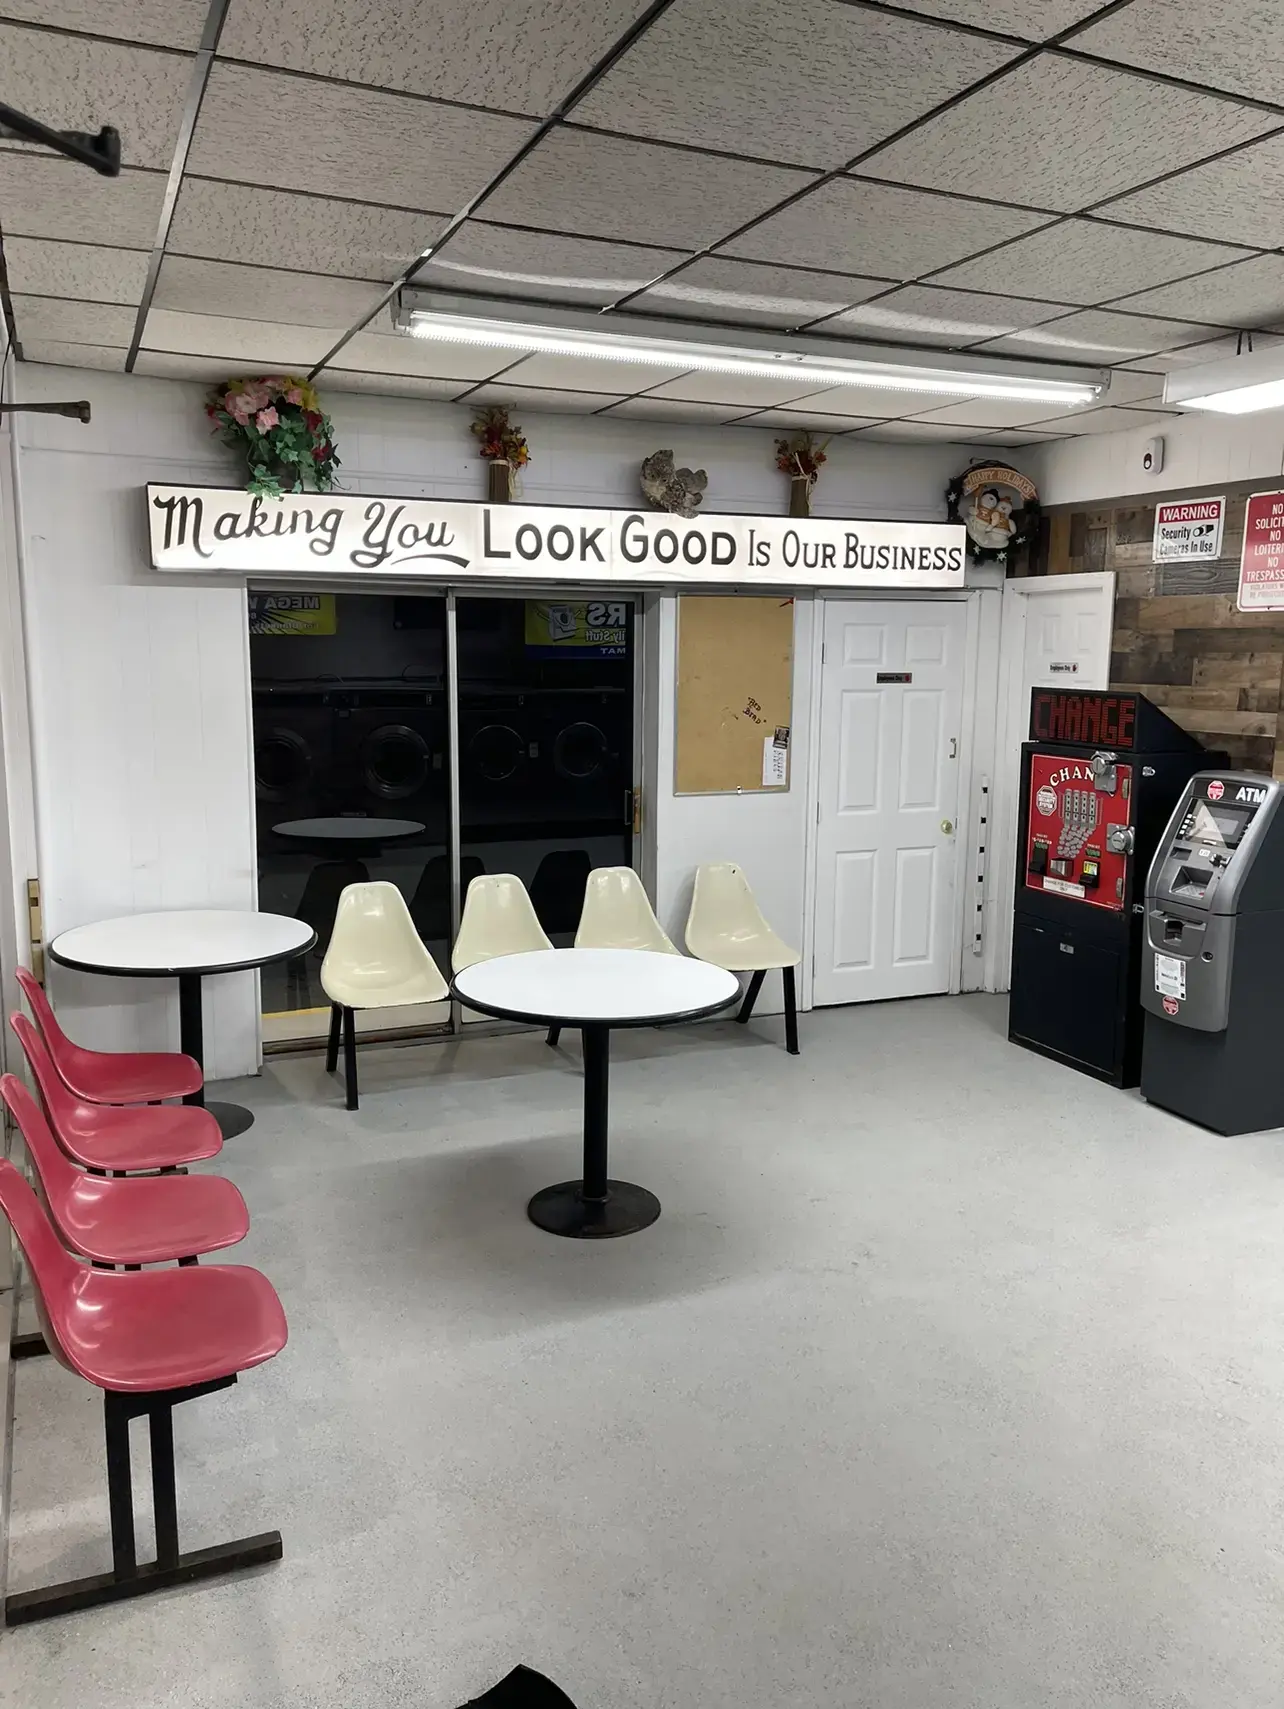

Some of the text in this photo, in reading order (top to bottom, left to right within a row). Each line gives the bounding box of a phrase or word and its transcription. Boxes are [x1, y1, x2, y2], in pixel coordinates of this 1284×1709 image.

[971, 471, 995, 483] HAPPY
[1162, 504, 1218, 522] WARNING
[1272, 503, 1284, 515] NO
[153, 495, 344, 558] Making
[349, 501, 456, 568] You
[1161, 526, 1191, 541] Security
[1269, 530, 1281, 541] NO
[1159, 540, 1213, 556] Cameras In Use
[1267, 557, 1279, 568] NO
[1034, 694, 1135, 747] CHANGE
[1235, 786, 1267, 803] ATM
